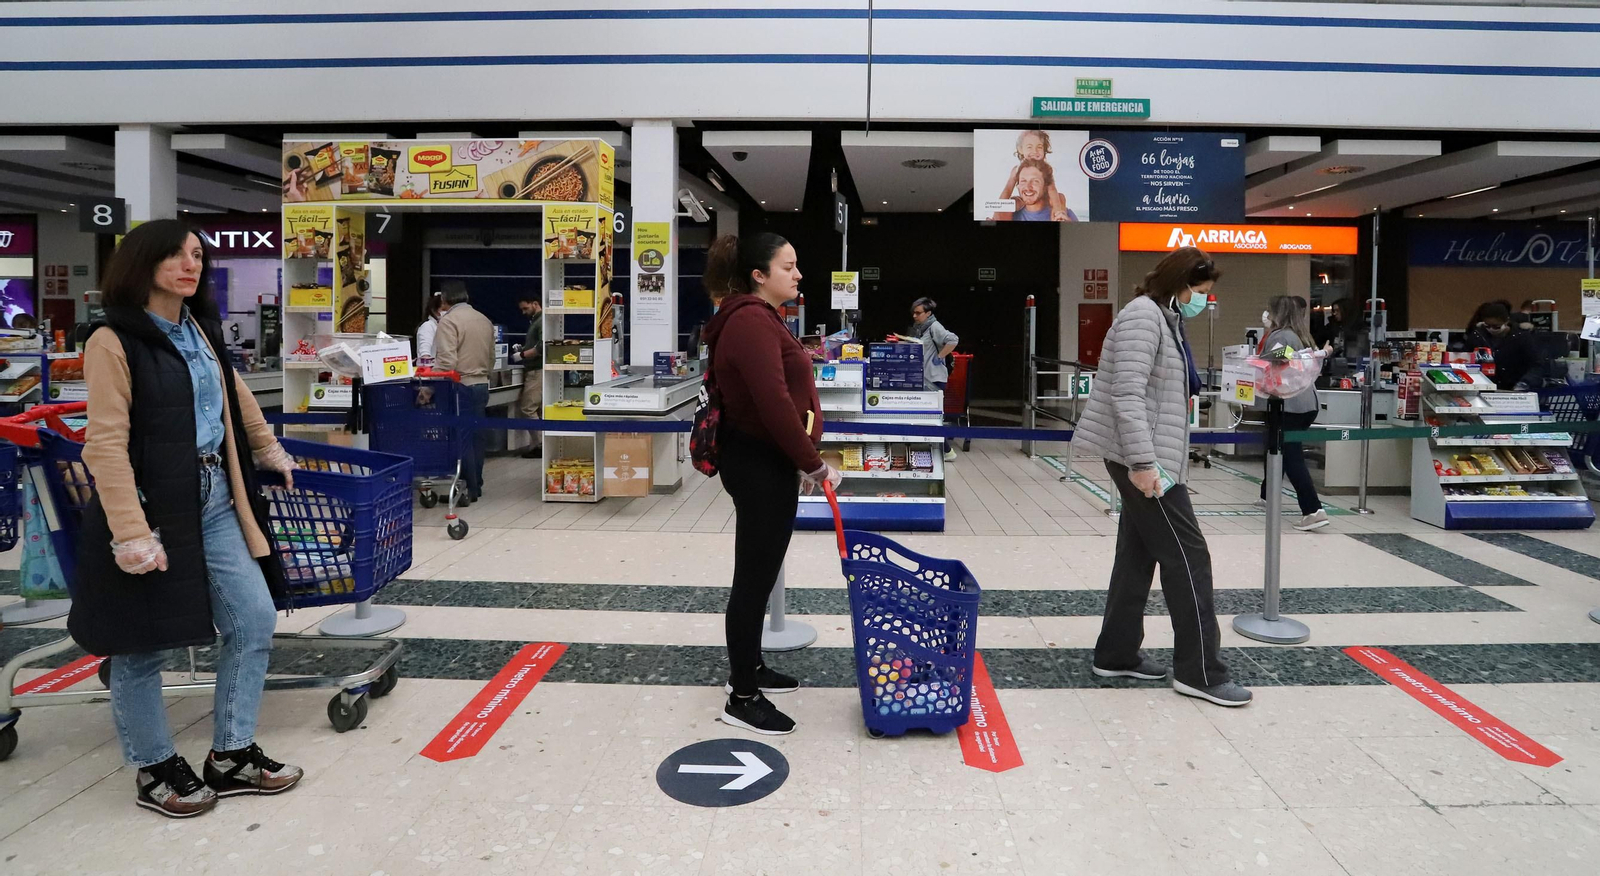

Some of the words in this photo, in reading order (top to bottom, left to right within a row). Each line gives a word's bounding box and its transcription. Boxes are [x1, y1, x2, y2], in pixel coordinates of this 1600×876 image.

[1040, 100, 1073, 111] SALIDA
[1074, 101, 1086, 112] DE
[1087, 101, 1144, 113] EMERGENCIA
[1092, 155, 1106, 164] FOR
[1092, 161, 1110, 171] FOOD
[1141, 153, 1156, 165] 66
[1160, 149, 1195, 170] lonjas
[433, 180, 469, 190] FUSIAN
[1142, 194, 1151, 205] a
[1154, 187, 1191, 205] diario
[93, 204, 113, 226] 8
[838, 201, 843, 224] 5
[1163, 204, 1176, 212] MÁS
[298, 215, 318, 223] fácil
[376, 213, 392, 234] 7
[560, 214, 581, 223] fácil
[613, 212, 625, 233] 6
[1197, 229, 1268, 244] ARRIAGA
[1443, 232, 1512, 263] Huelva
[505, 667, 532, 689] metro
[476, 688, 512, 719] mínimo
[1395, 671, 1433, 693] metro
[1429, 693, 1481, 724] mínimo
